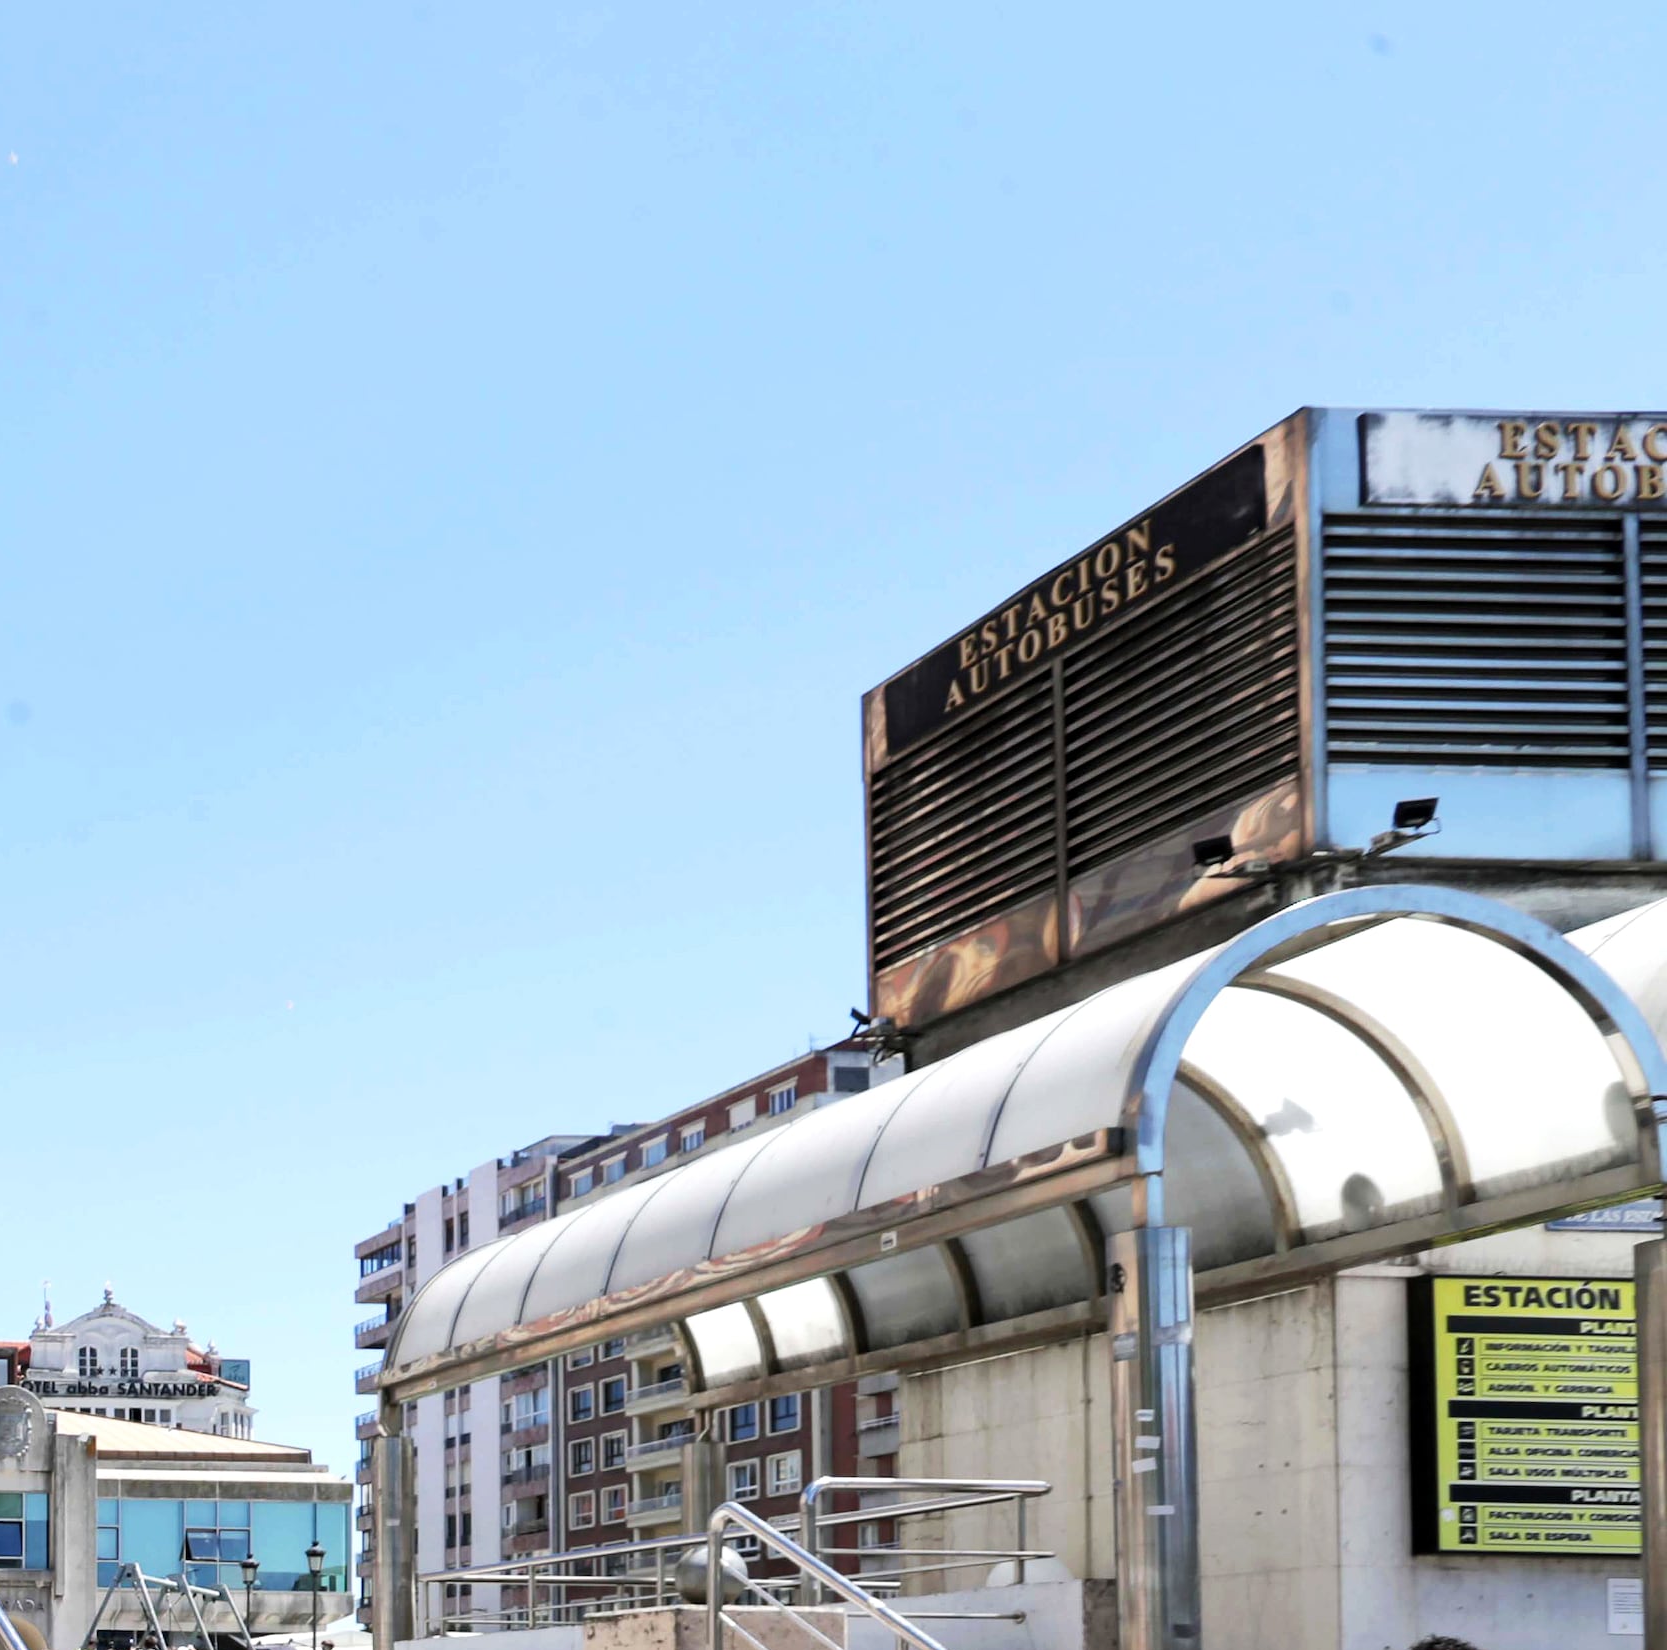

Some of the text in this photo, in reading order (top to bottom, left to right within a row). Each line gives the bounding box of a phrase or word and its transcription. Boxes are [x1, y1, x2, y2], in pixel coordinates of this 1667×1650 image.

[1496, 420, 1667, 461] ESTAC
[1472, 462, 1667, 500] AUTOB
[958, 518, 1152, 670] ESTACION
[944, 543, 1176, 713] AUTOBUSES
[1463, 1281, 1621, 1311] ESTACIÓN
[1580, 1321, 1636, 1335] PLANT
[1576, 1344, 1583, 1352] Y
[1486, 1362, 1631, 1374] CAJEROS AUTOMÁTICOS
[21, 1380, 217, 1397] OTEL abba SANTANDER
[1543, 1385, 1551, 1393] Y
[1555, 1385, 1614, 1394] GERENCIA
[1581, 1405, 1639, 1419] PLANT
[1487, 1426, 1628, 1438] TARJETA TRANSPORTE
[1578, 1449, 1641, 1458] COMERCIA
[1488, 1467, 1628, 1479] SALA USOS MÚLTIPLES
[1488, 1511, 1573, 1521] FACTURACIÓN
[1578, 1513, 1586, 1521] Y
[1488, 1532, 1592, 1542] SALA DE ESPERA
